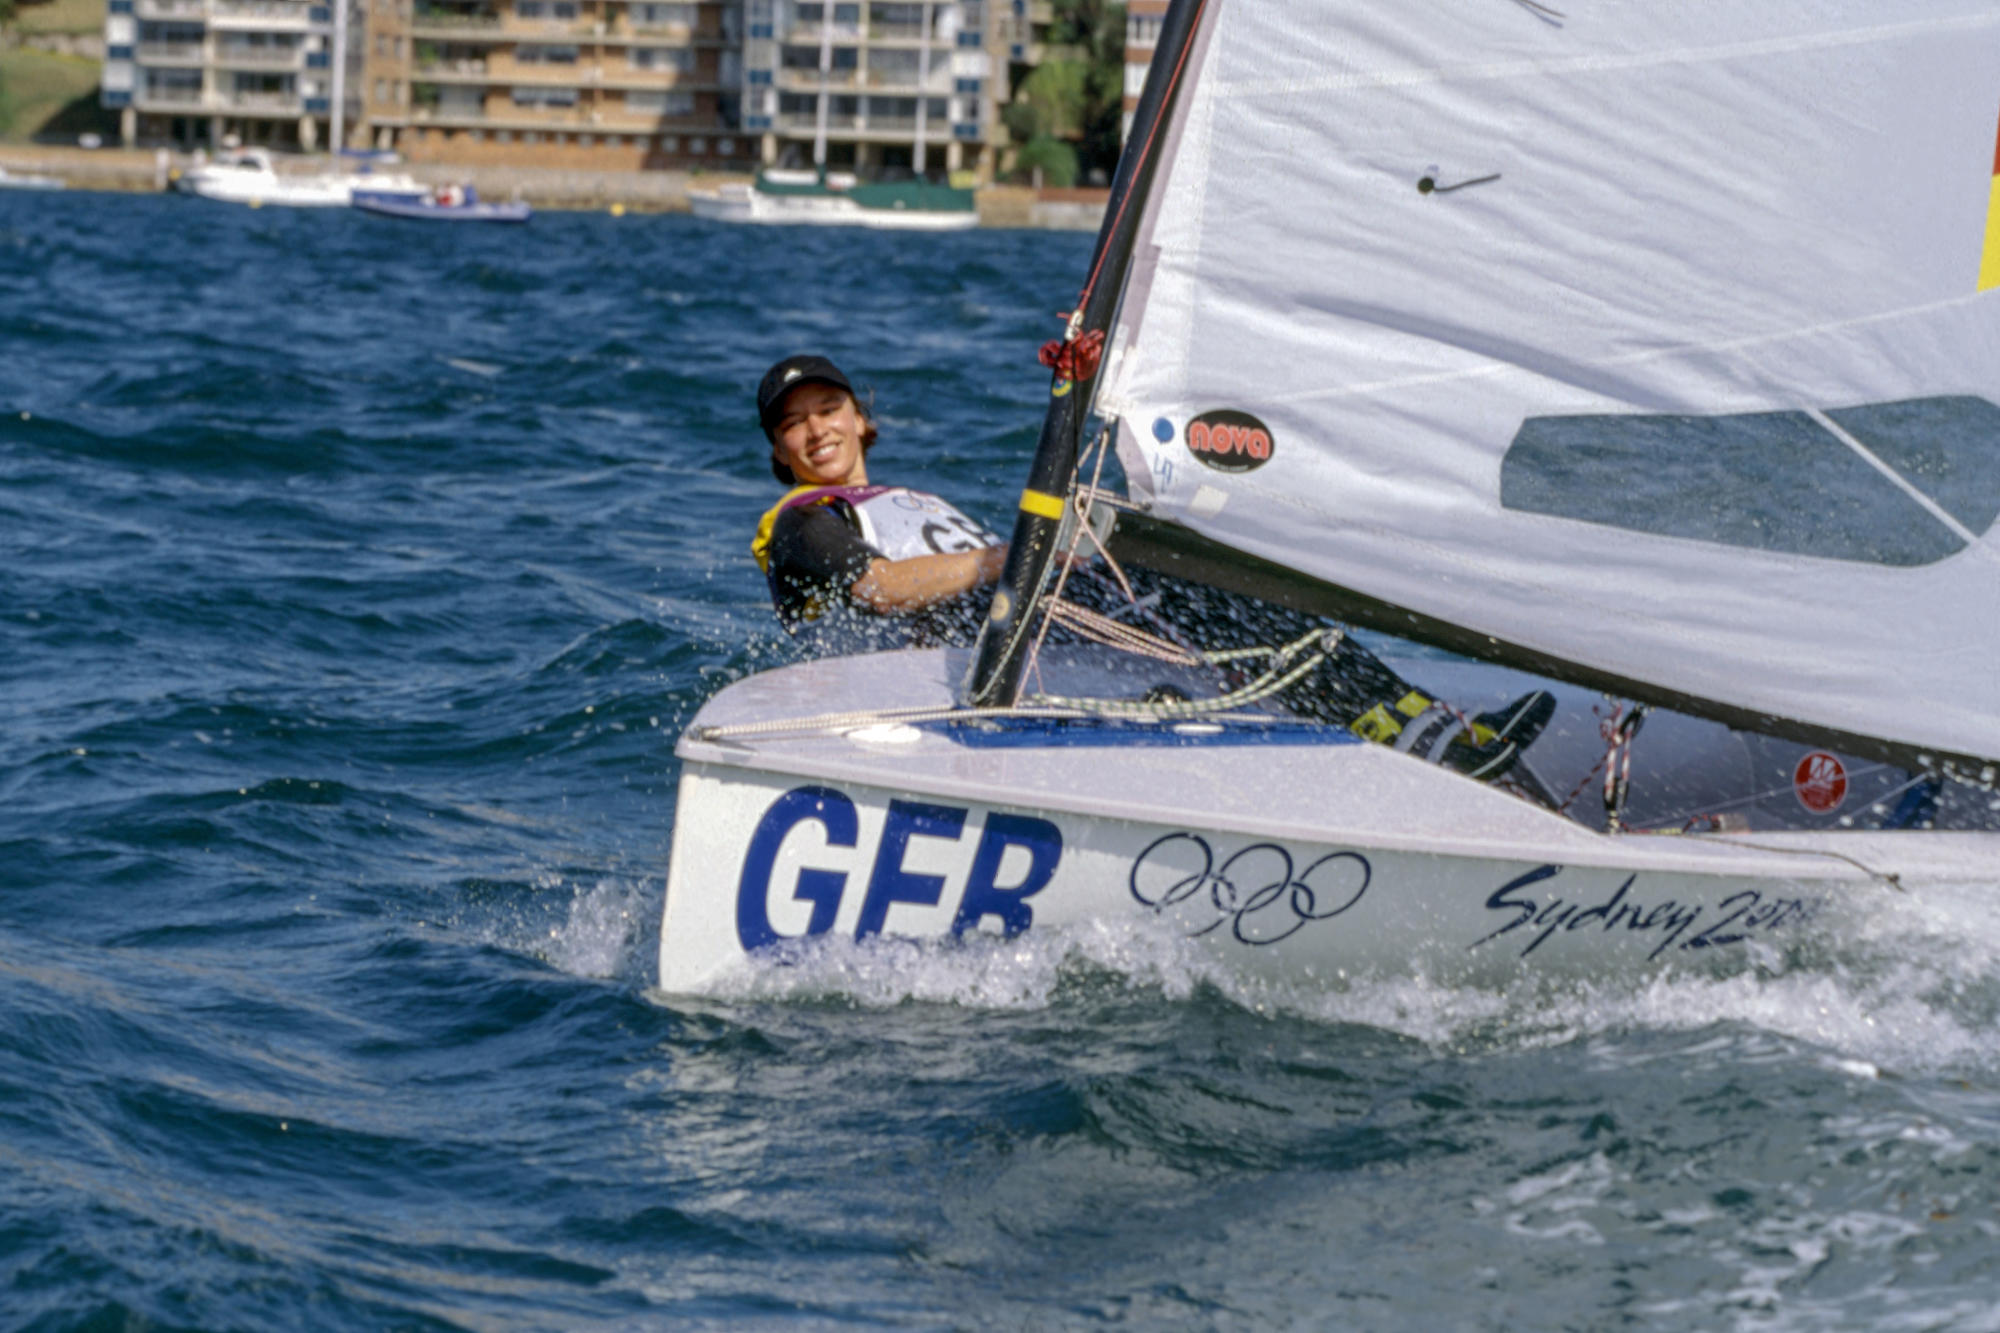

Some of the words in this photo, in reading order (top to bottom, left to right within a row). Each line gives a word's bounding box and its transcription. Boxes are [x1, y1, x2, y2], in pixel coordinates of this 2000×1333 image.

[1188, 419, 1271, 460] nova
[735, 785, 1064, 962] GER
[1466, 864, 1702, 961] Sydney
